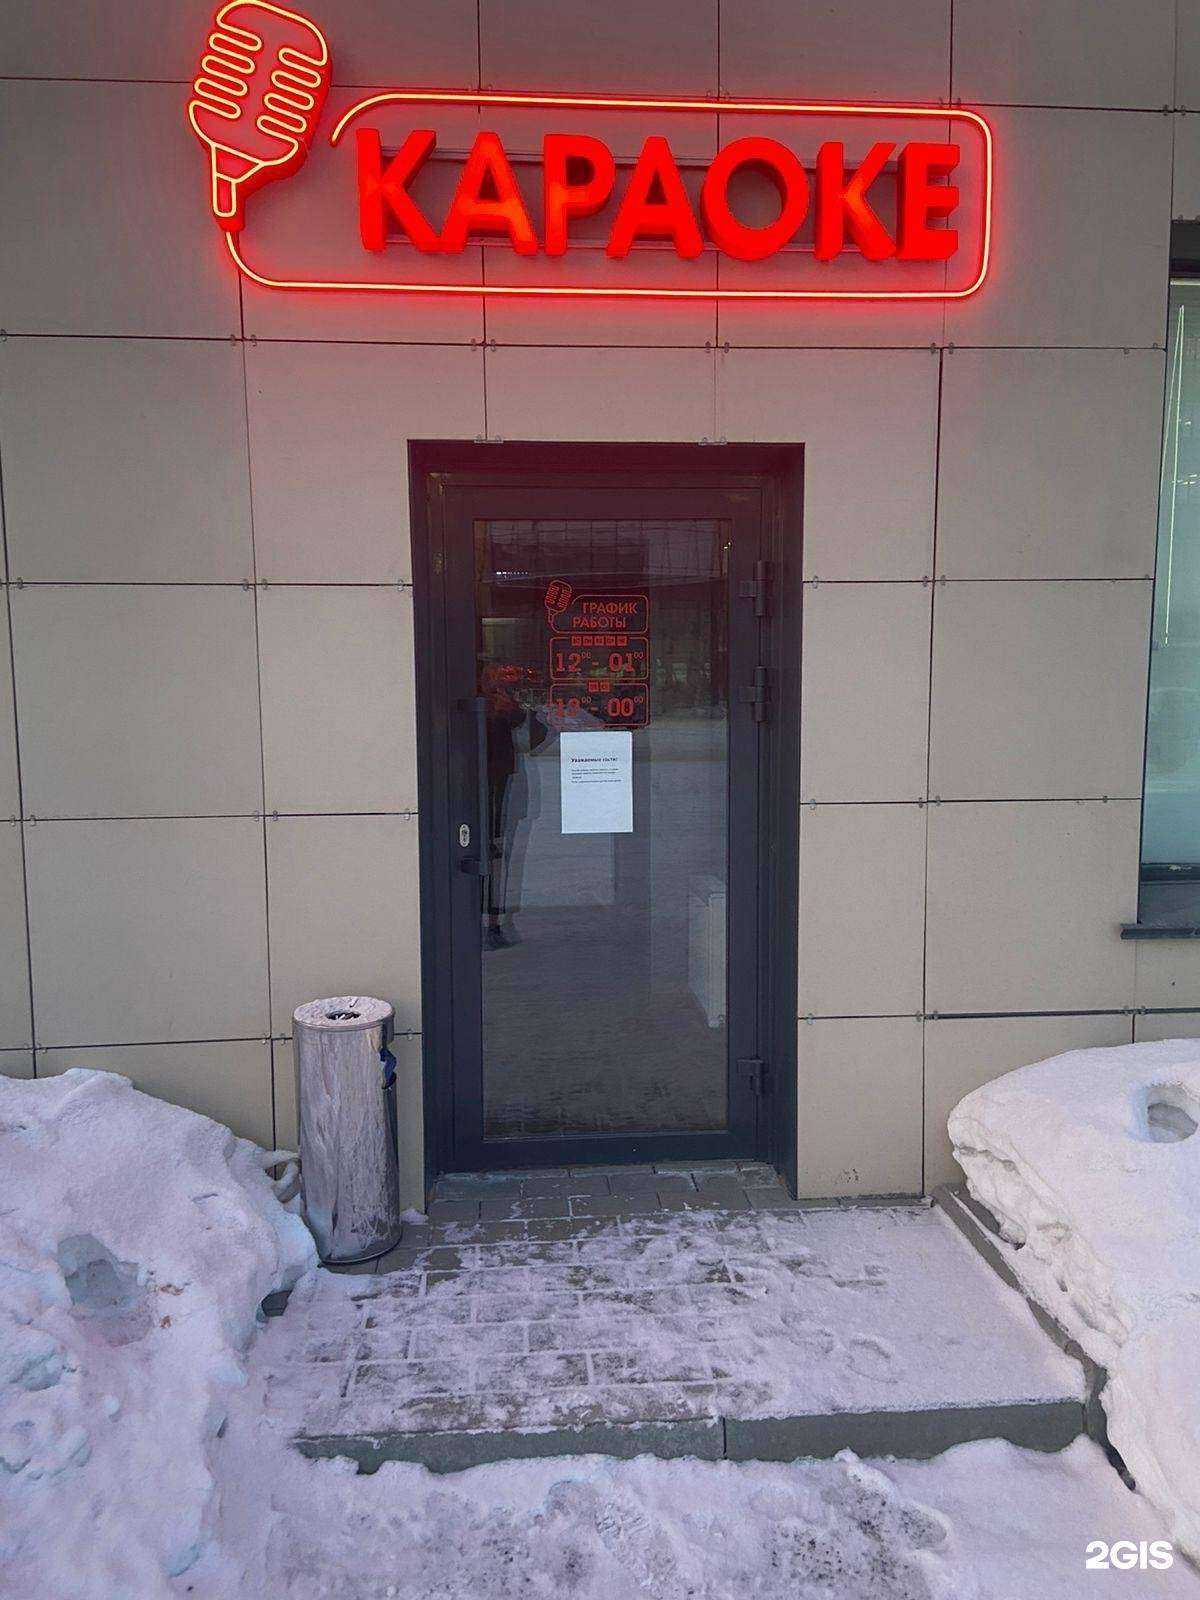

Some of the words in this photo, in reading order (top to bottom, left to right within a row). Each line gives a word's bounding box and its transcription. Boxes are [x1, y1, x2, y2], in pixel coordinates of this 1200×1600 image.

[356, 128, 960, 261] КАРАОКЕ
[582, 602, 638, 614] ГРАФИК
[572, 616, 627, 629] РАБОТЫ
